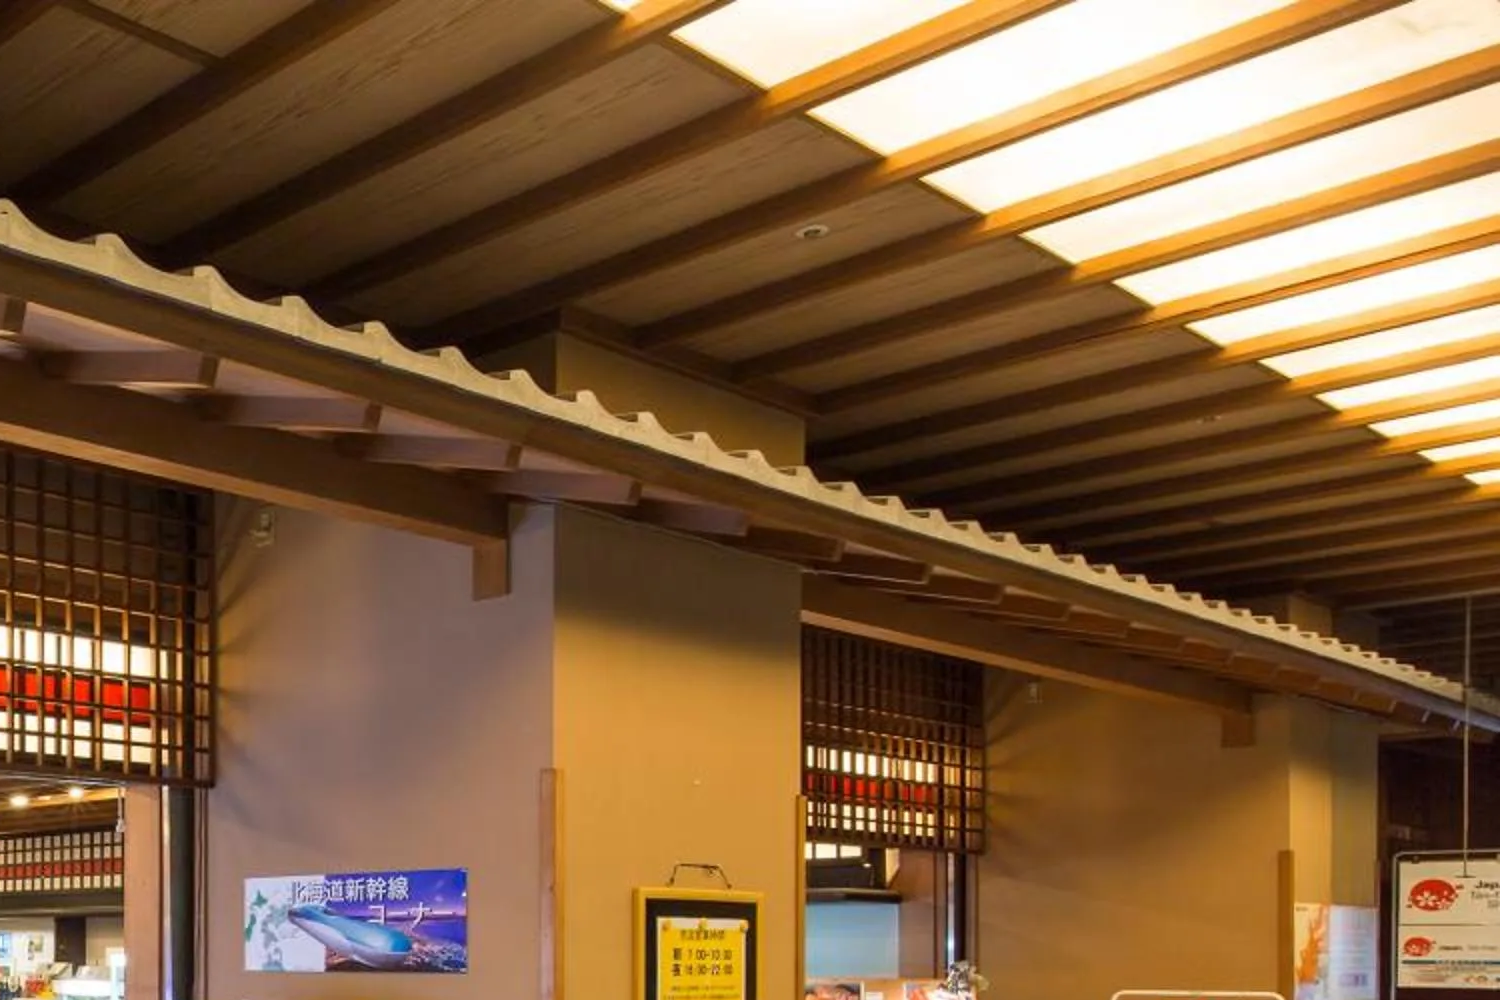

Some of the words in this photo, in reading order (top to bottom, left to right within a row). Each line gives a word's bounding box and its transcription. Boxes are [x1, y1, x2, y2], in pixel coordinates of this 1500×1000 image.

[291, 876, 409, 905] 北海道新幹線
[367, 901, 454, 929] コーナー
